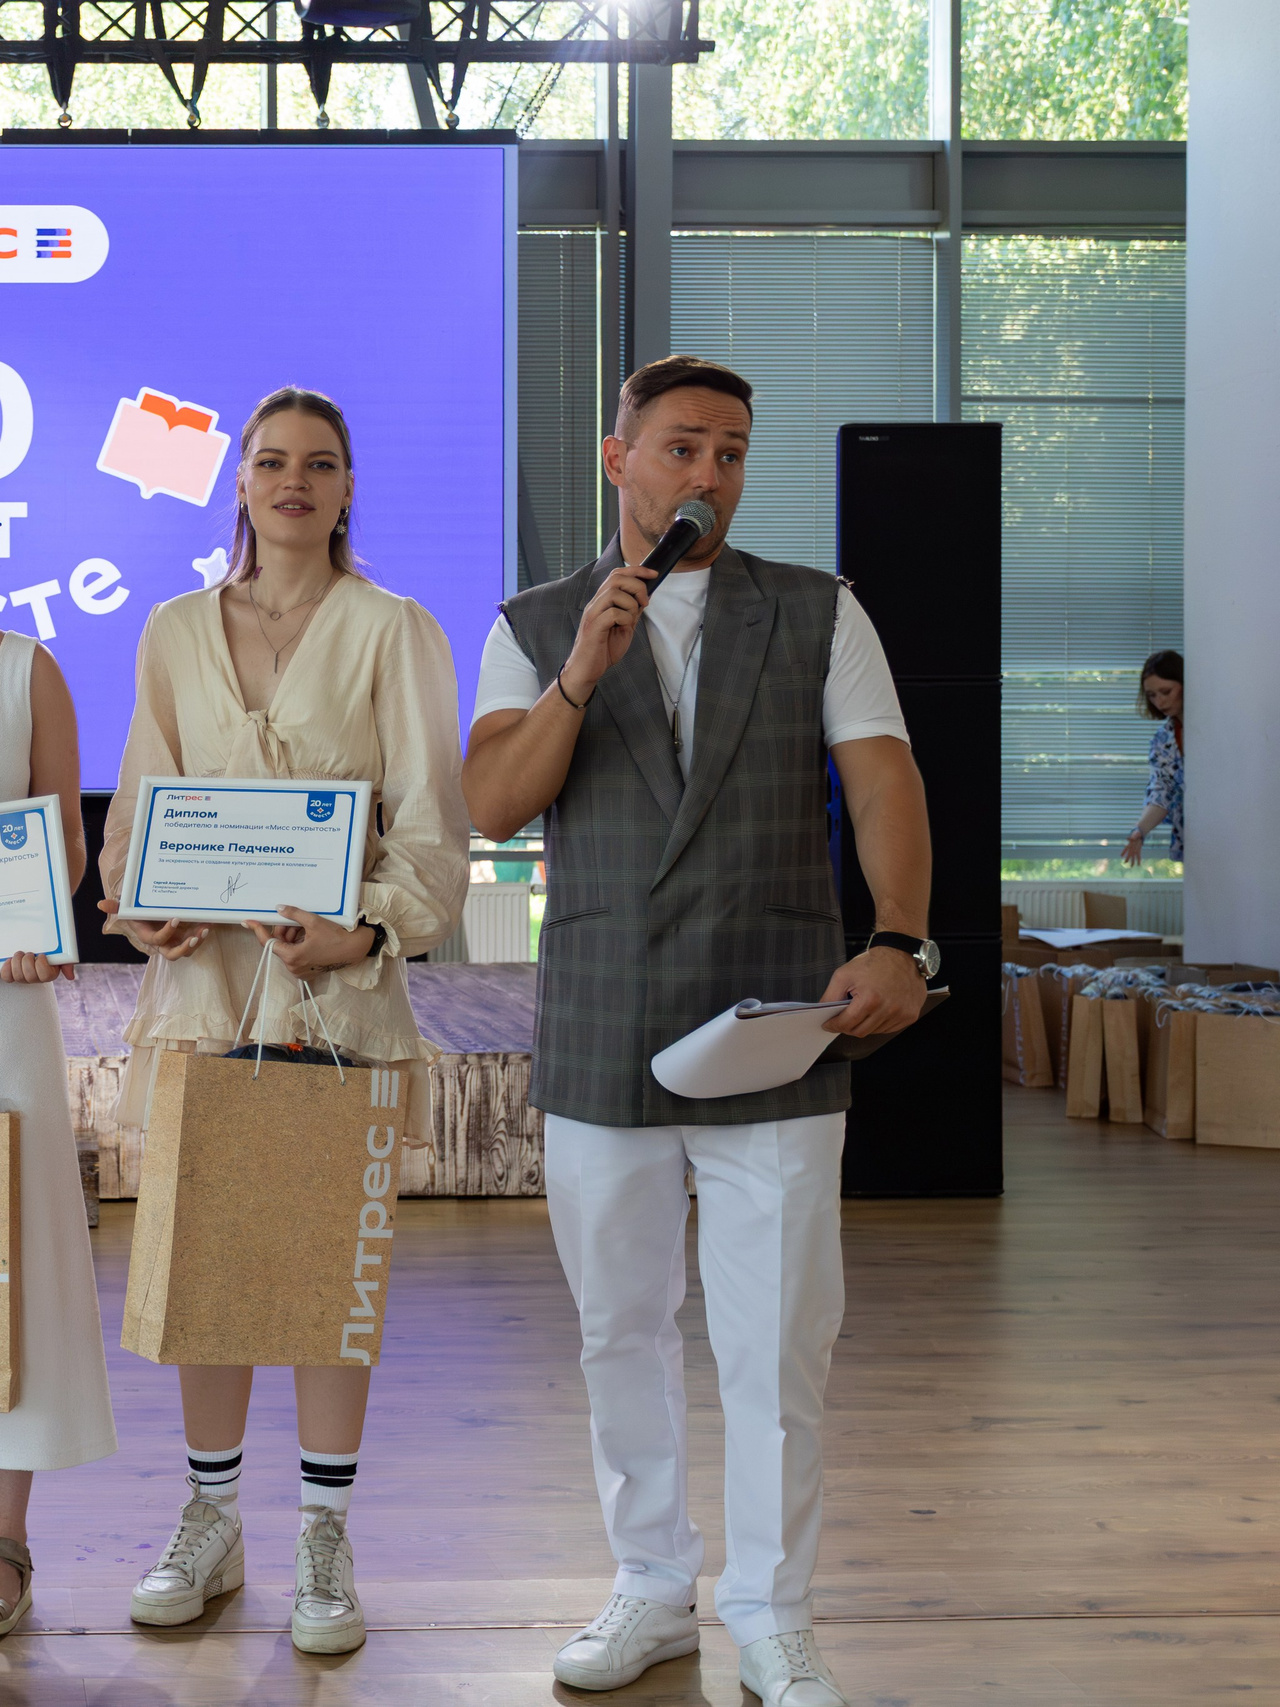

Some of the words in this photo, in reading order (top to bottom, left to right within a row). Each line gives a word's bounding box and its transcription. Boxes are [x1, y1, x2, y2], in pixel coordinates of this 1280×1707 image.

[164, 808, 218, 819] Диплом
[2, 824, 13, 833] 20
[164, 821, 212, 829] победителю
[291, 825, 341, 833] открытость»
[5, 835, 25, 845] вместе
[159, 841, 225, 852] Веронике
[228, 842, 295, 854] Педченко
[340, 1125, 395, 1366] Литрес
